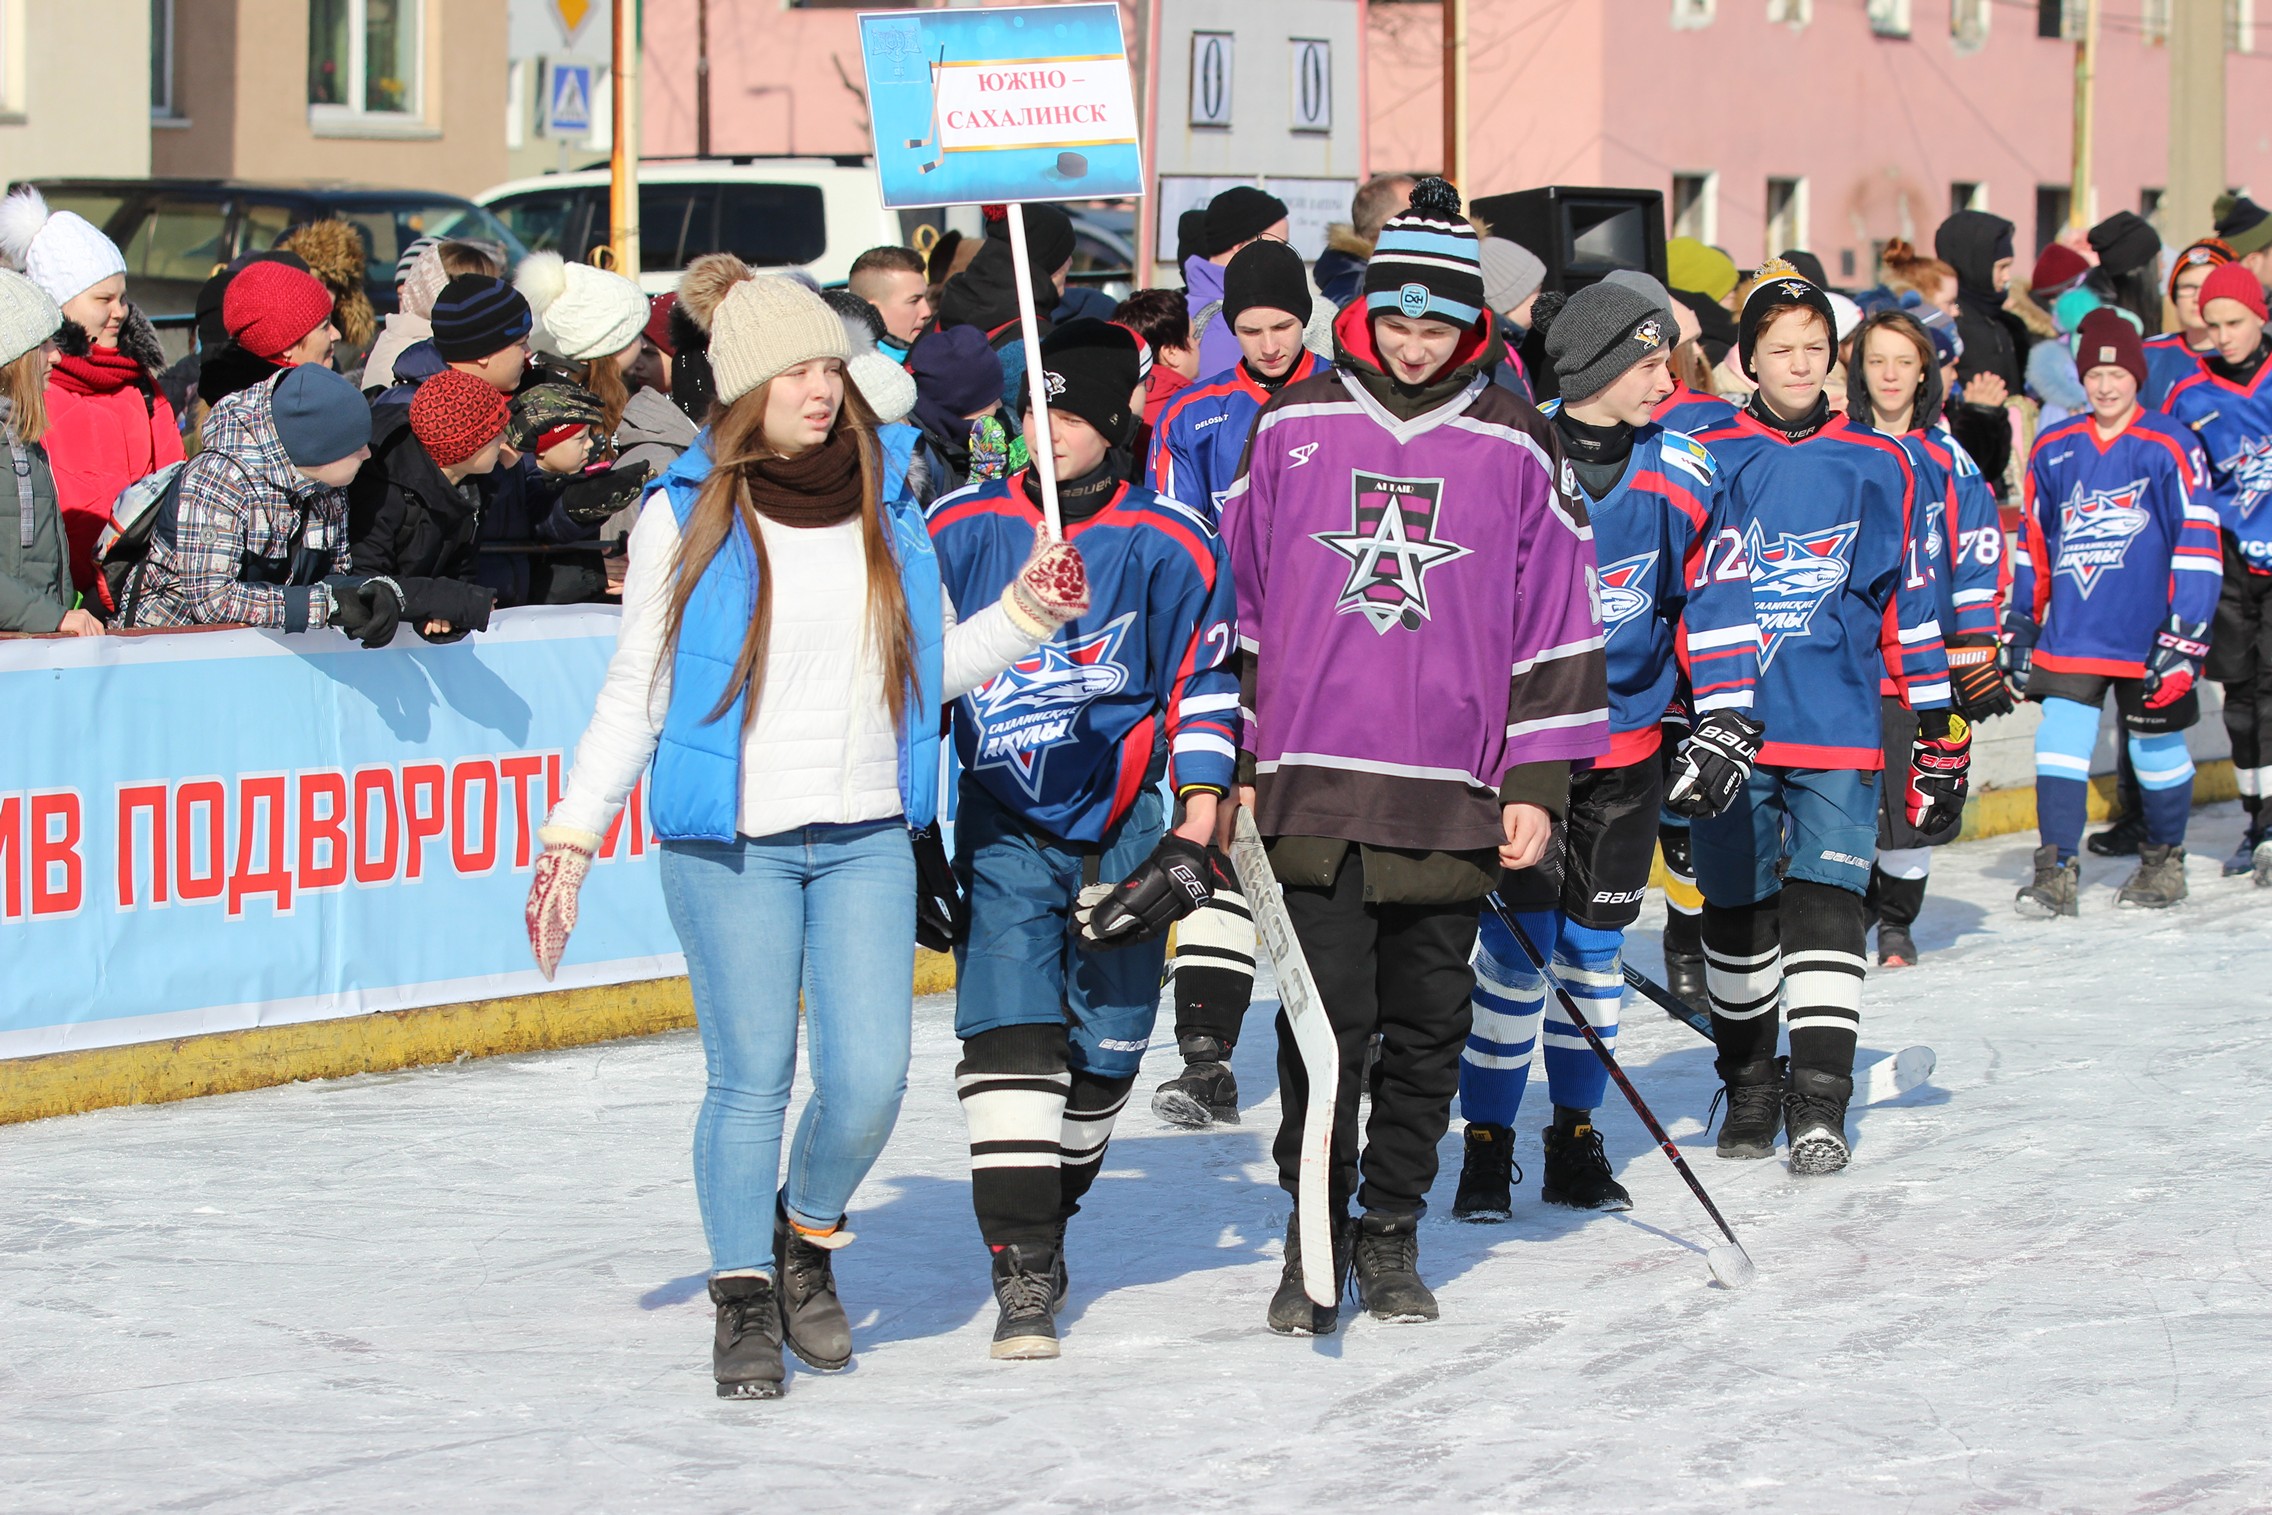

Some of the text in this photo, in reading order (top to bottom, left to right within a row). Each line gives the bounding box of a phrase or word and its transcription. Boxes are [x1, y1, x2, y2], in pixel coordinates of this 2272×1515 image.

[977, 70, 1066, 92] ЮЖНО
[947, 104, 1108, 130] САХАЛИНСК
[1956, 526, 2000, 565] 78
